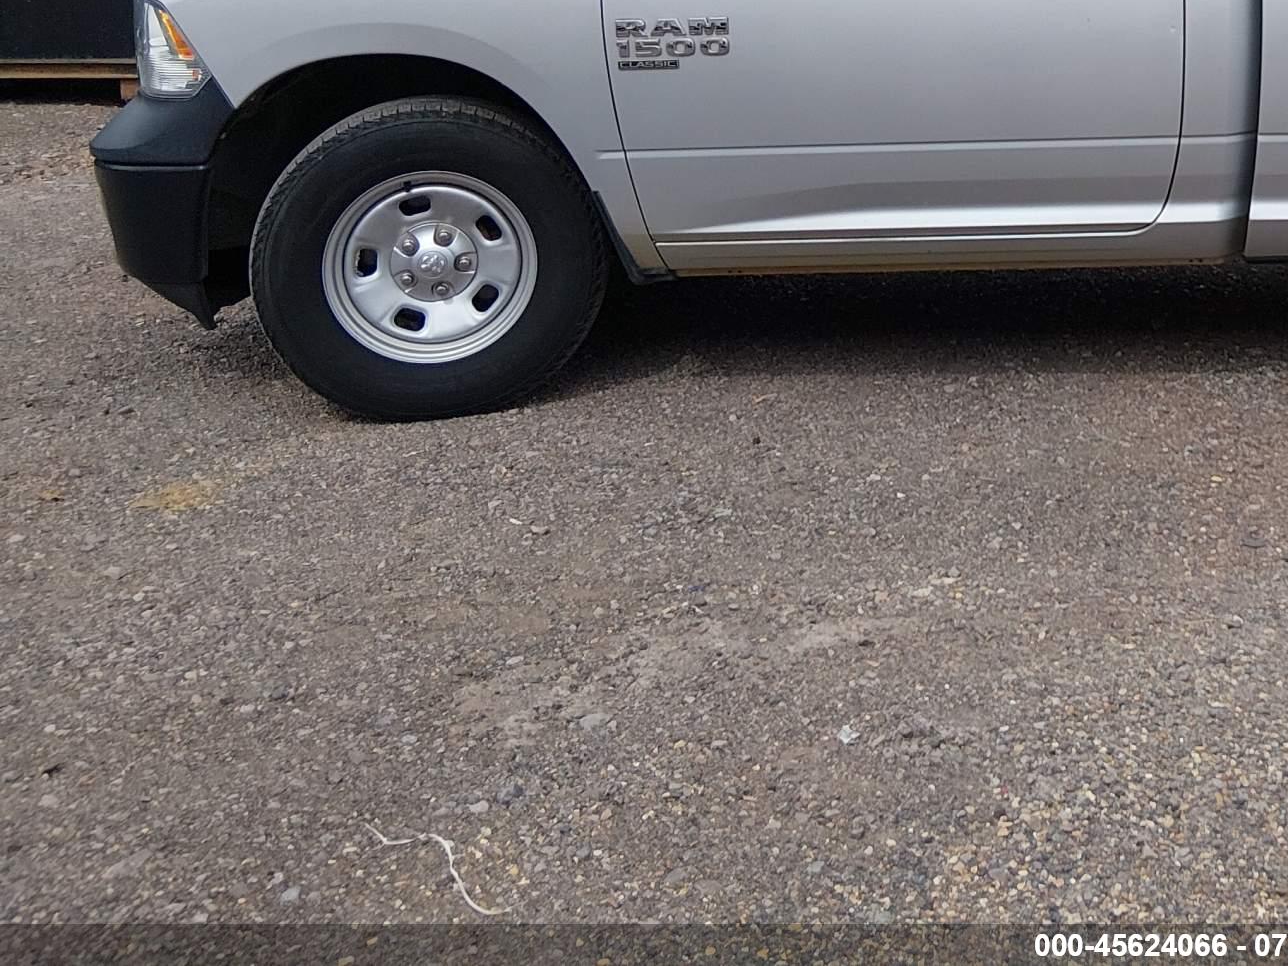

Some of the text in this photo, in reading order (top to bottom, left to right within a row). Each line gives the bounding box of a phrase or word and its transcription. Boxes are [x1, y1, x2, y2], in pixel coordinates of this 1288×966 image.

[615, 17, 729, 37] RAM
[616, 37, 730, 58] 1500
[619, 60, 678, 69] CLASSIC
